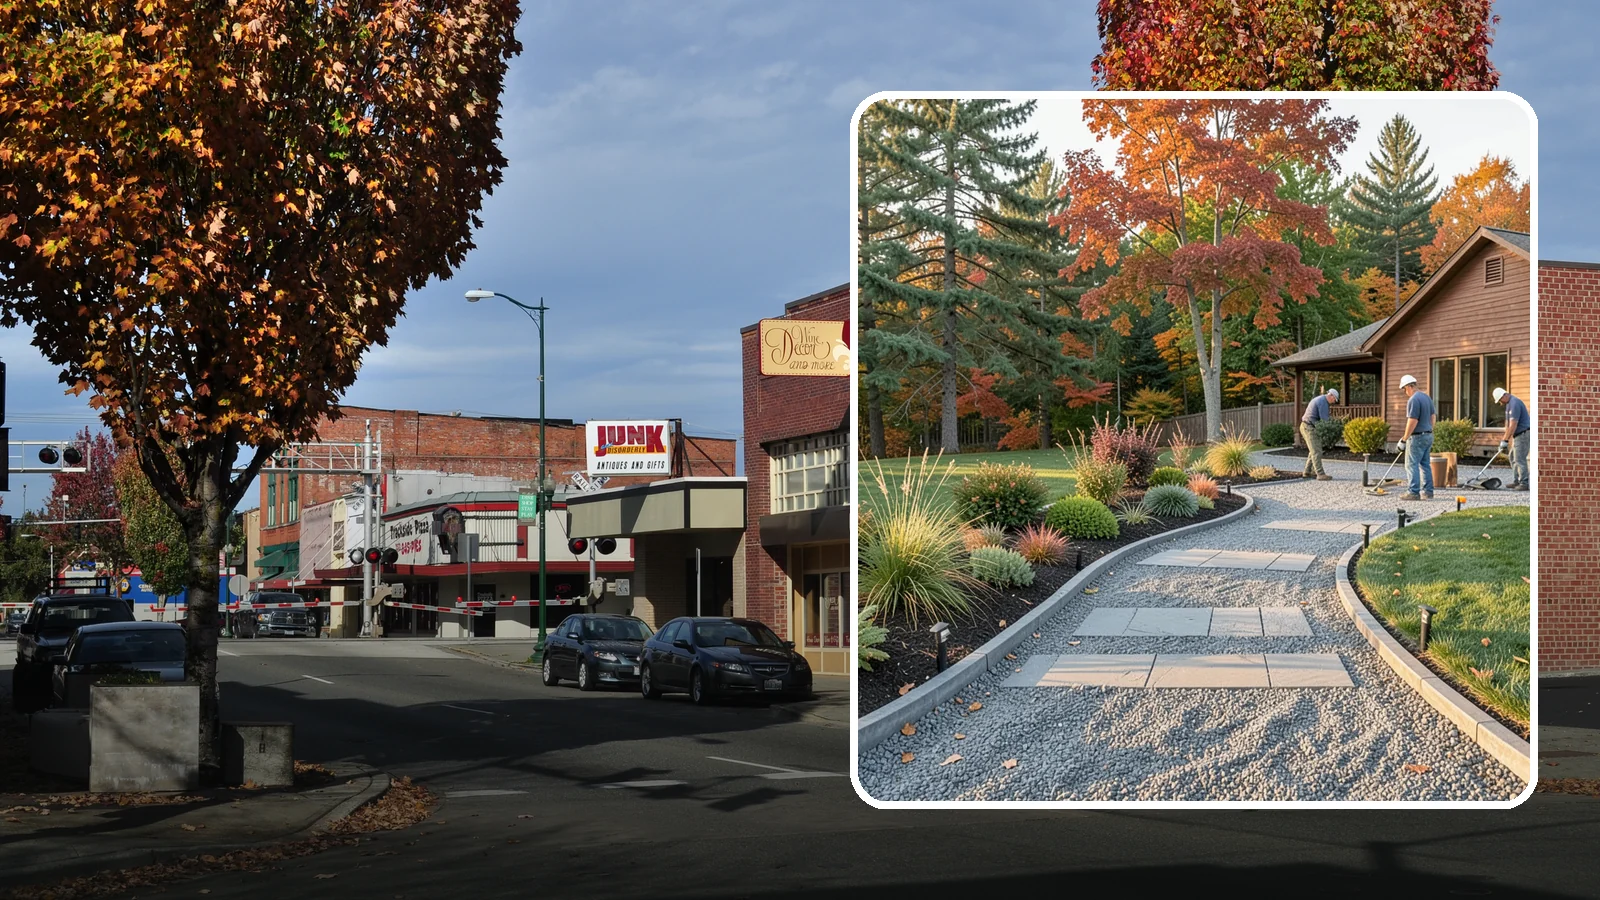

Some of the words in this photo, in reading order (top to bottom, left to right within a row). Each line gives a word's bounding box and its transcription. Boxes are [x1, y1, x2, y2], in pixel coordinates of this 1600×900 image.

[595, 425, 665, 457] JUNK
[607, 446, 646, 454] DISORDERLY
[596, 461, 628, 470] ANTIQUES
[631, 461, 644, 470] AND
[646, 460, 665, 470] GIFTS
[390, 521, 413, 539] Trackside
[414, 519, 429, 535] Pizza
